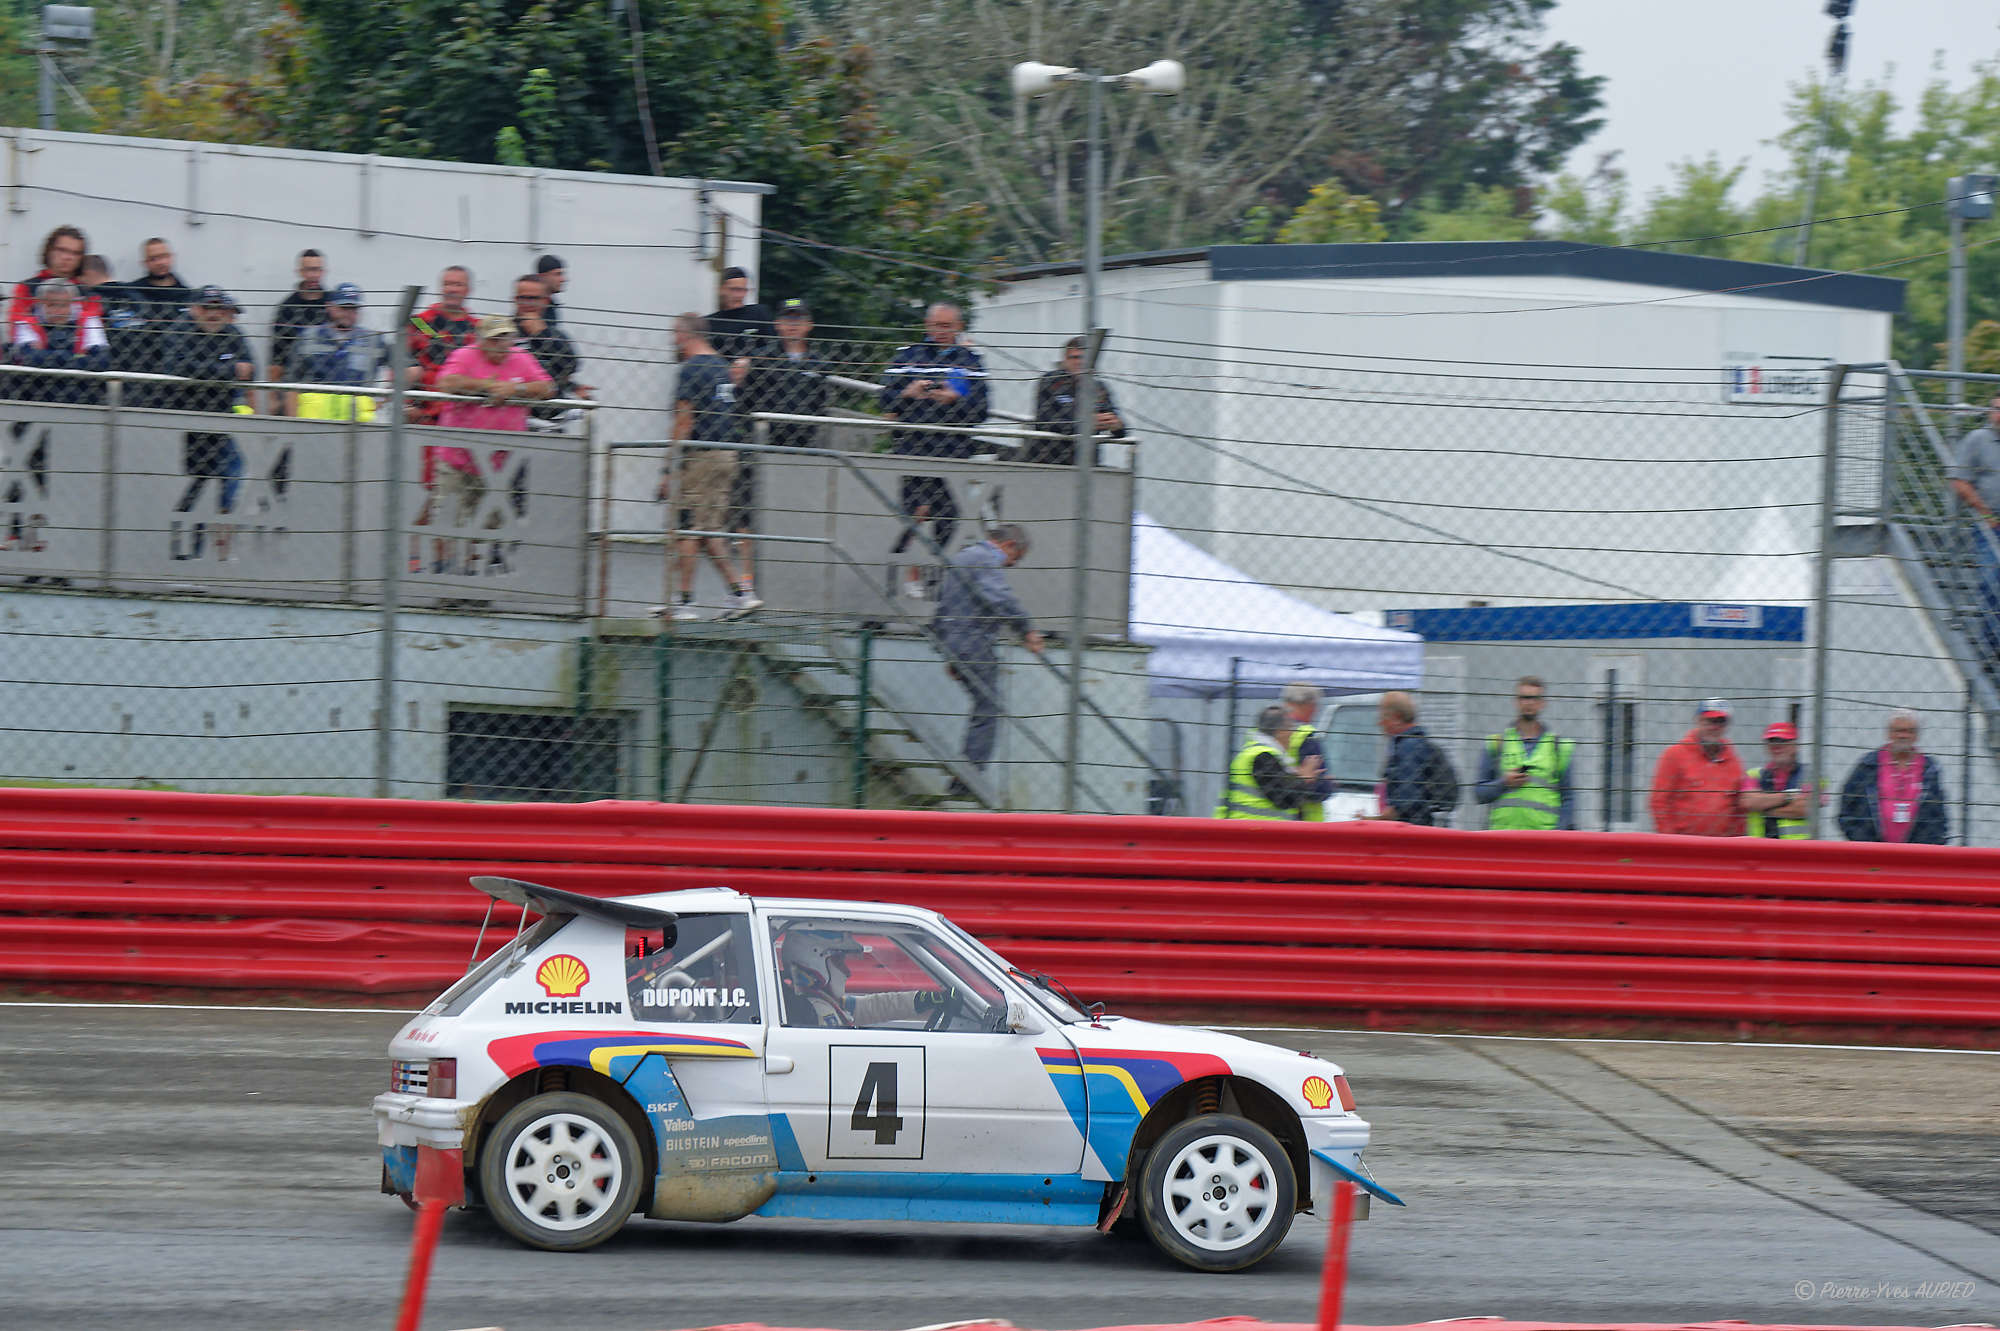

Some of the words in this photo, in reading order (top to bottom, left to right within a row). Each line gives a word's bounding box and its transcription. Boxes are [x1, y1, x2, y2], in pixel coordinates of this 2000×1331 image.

[643, 988, 716, 1007] DUPONT
[719, 988, 751, 1007] J.C.
[504, 1001, 622, 1015] MICHELIN
[646, 1102, 679, 1113] SKF
[851, 1062, 904, 1145] 4
[663, 1119, 695, 1132] Valeo
[666, 1136, 720, 1151] BILSTEIN
[723, 1135, 768, 1147] speedline
